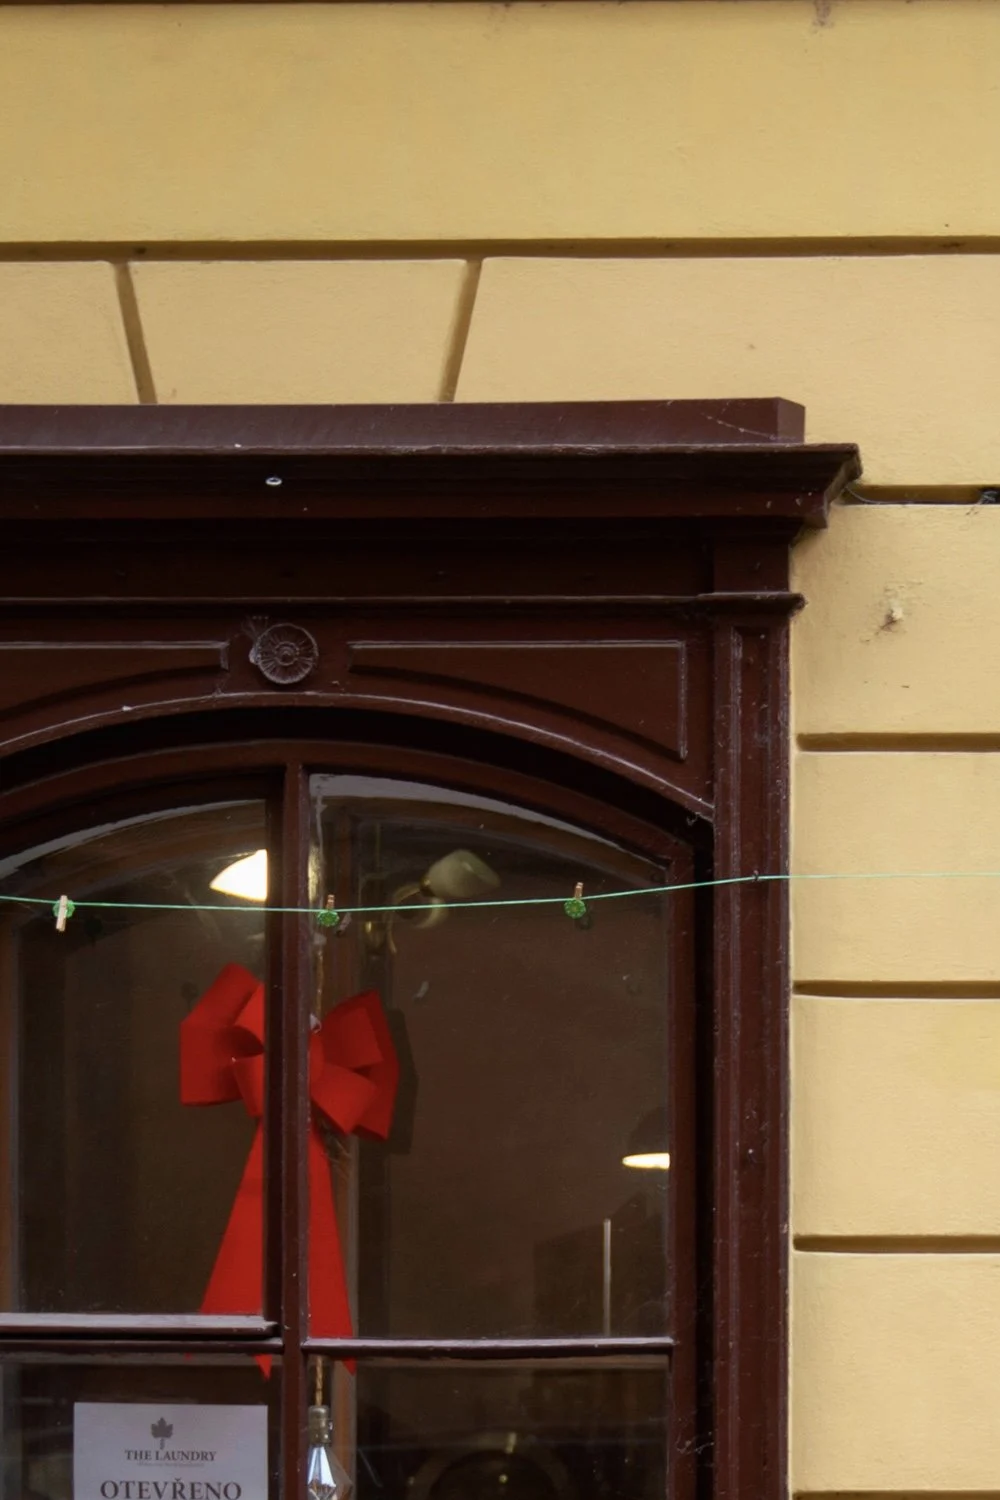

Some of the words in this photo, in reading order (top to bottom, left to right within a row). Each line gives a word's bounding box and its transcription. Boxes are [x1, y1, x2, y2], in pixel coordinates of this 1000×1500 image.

[125, 1450, 152, 1461] THE
[155, 1451, 217, 1461] LAUNDRY
[100, 1477, 242, 1500] OTEVŘENO
